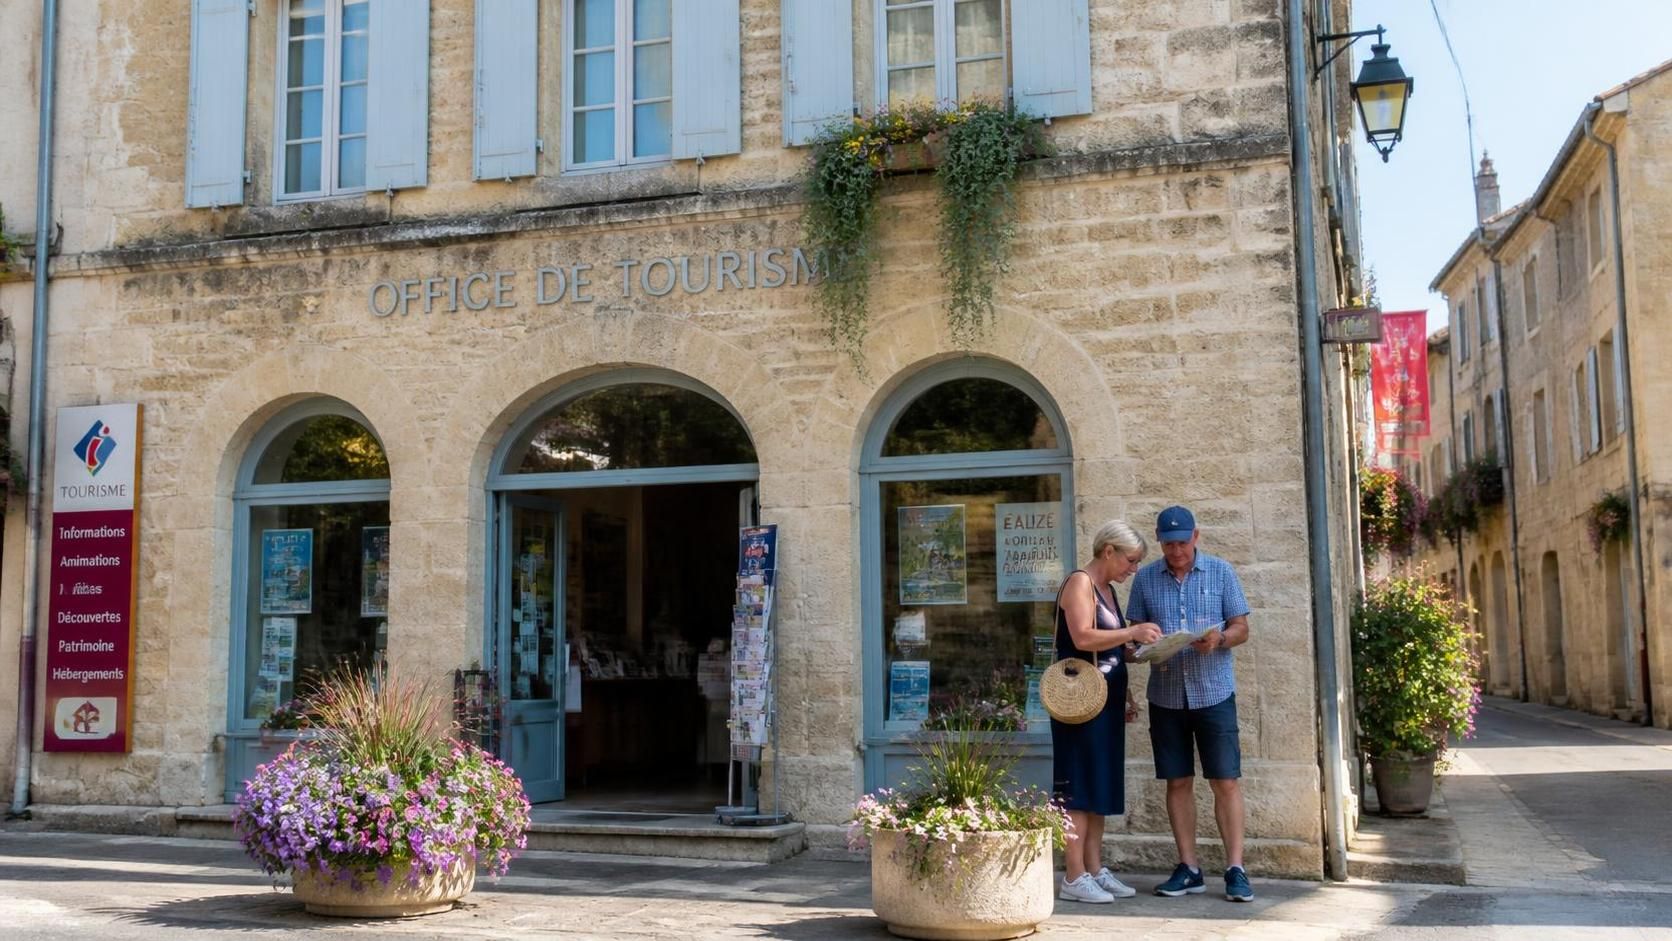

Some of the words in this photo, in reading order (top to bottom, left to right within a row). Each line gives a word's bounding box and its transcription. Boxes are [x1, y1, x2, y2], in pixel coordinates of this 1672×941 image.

[368, 271, 517, 317] OFFICE
[537, 263, 594, 305] DE
[612, 246, 846, 298] TOURISM
[60, 483, 128, 499] TOURISME
[59, 525, 126, 540] Informations
[57, 611, 122, 624] Découvertes
[58, 639, 115, 653] Patrimoine
